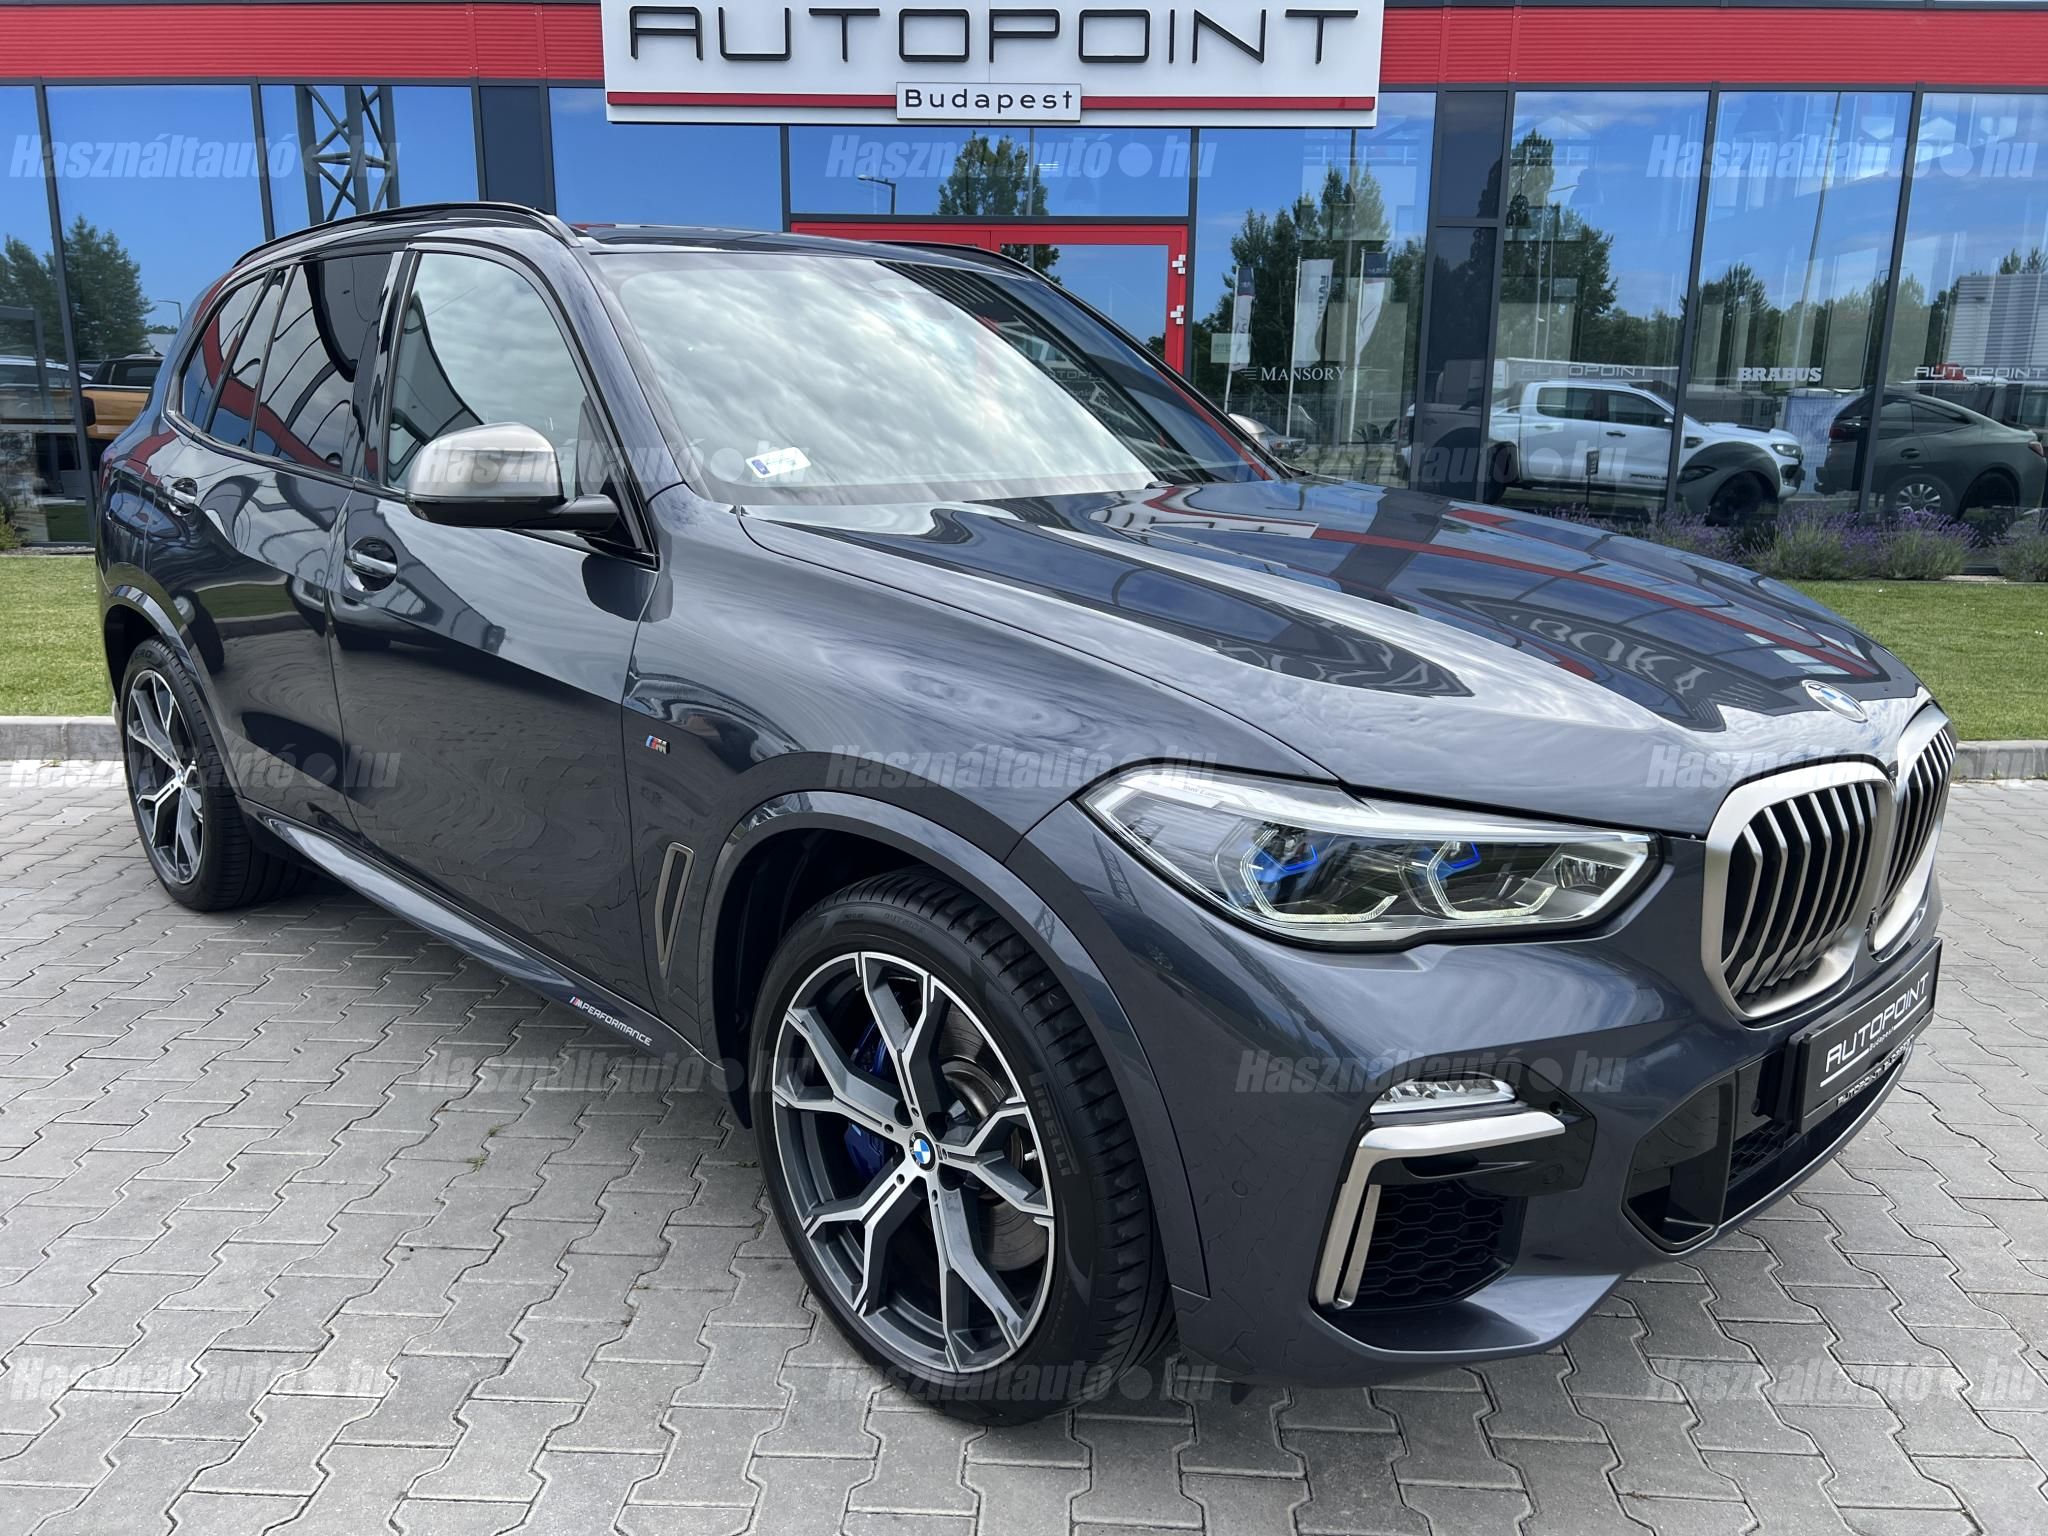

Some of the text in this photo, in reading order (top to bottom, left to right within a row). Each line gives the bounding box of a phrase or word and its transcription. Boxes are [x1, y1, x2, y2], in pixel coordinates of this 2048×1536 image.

[629, 6, 1359, 64] AUTOPOINT
[904, 87, 1074, 115] Budapest
[1261, 366, 1347, 381] MANSORY
[1521, 364, 1648, 378] AUTOPOINT
[1736, 366, 1822, 382] BRABUS
[1914, 365, 2047, 379] AUTOPOINT
[580, 1003, 653, 1047] PERFORMANCE
[1825, 972, 1930, 1073] AUTOPOINT
